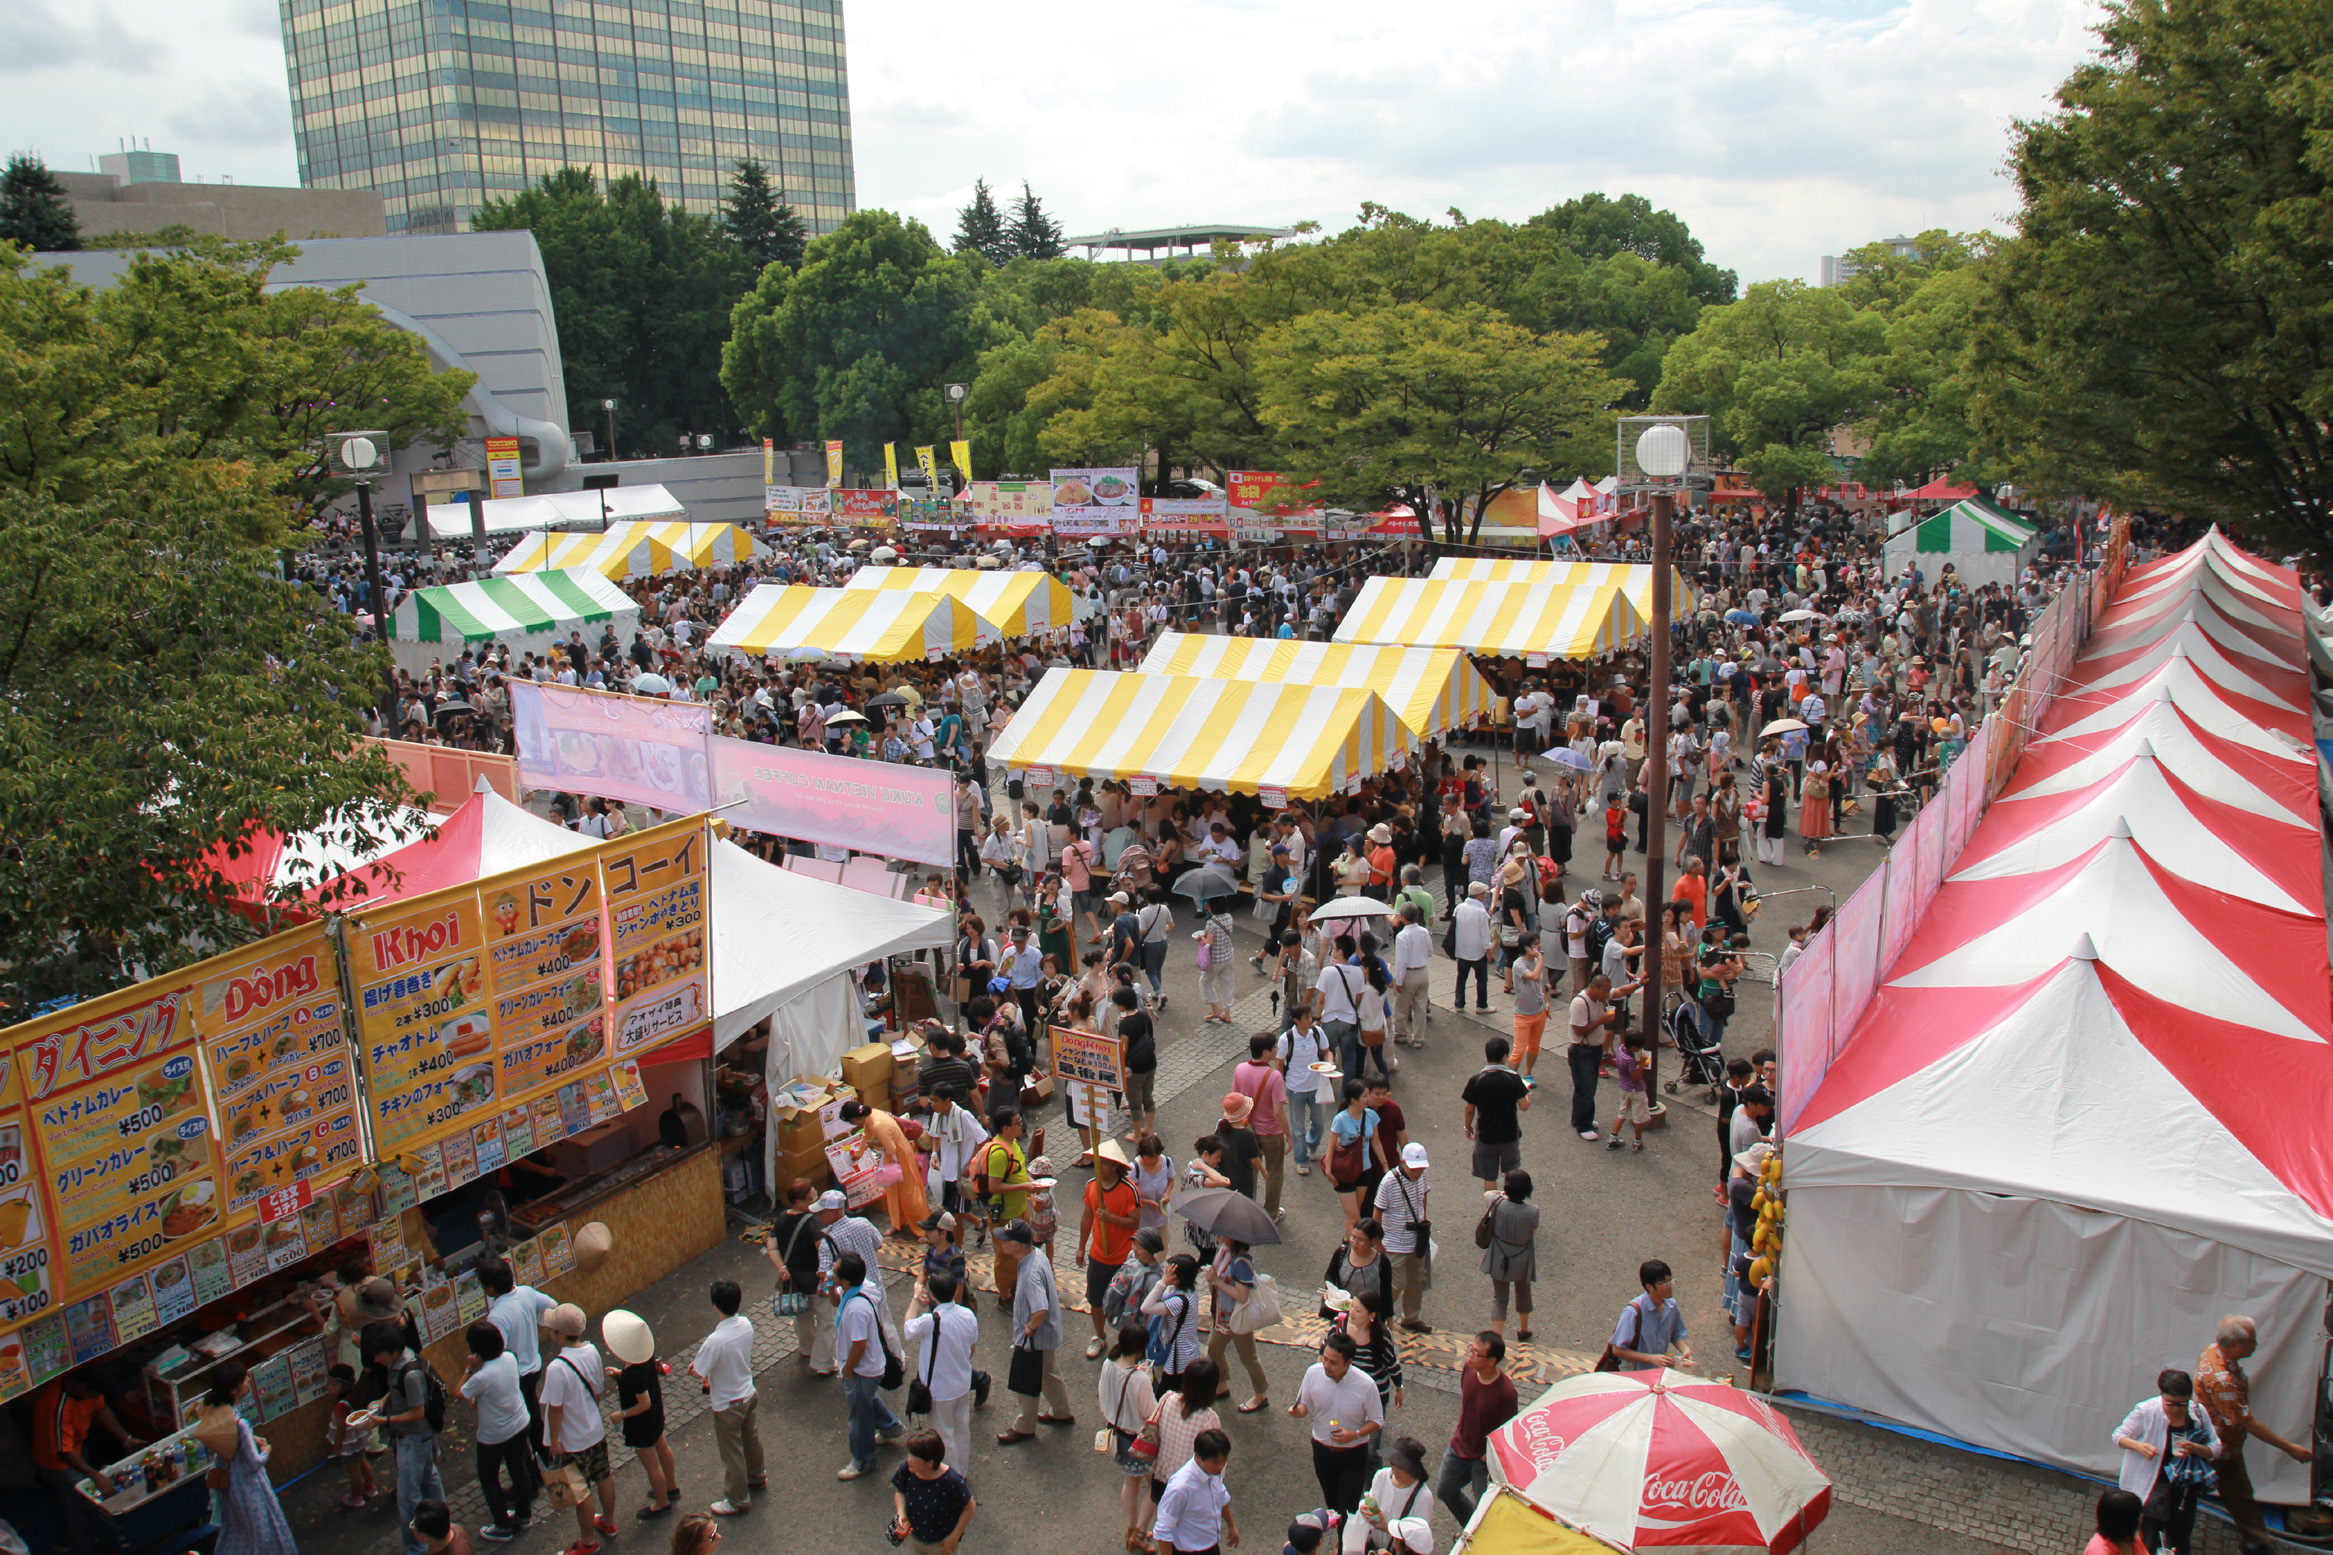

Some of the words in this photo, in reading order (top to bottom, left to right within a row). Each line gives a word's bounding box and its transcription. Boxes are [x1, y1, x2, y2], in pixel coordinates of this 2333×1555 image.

[1237, 485, 1260, 499] 池袋
[528, 875, 593, 929] ドン
[608, 833, 696, 895] コーイ
[649, 881, 700, 908] ベトナム風
[616, 895, 699, 938] ジャンボやきとり
[666, 910, 701, 931] ¥300
[493, 932, 569, 962] ベトナムカレーフォー
[537, 954, 570, 977] ¥400
[363, 970, 433, 1009] 揚げ春巻き
[499, 984, 572, 1018] グリーンカレーフォー
[395, 1014, 413, 1028] 2本
[413, 996, 450, 1021] ¥300
[541, 1006, 574, 1029] ¥400
[216, 1015, 291, 1063] ハーフ&ハーフ
[308, 1027, 341, 1053] ¥700
[626, 1010, 683, 1044] 大盛りサービス
[31, 993, 182, 1098] ダイニング
[372, 1025, 440, 1065] チャオトム
[268, 1051, 307, 1070] グリーンカレー
[418, 1049, 454, 1075] ¥400
[545, 1054, 576, 1078] ¥400
[220, 1071, 261, 1095] ベトナムカレー
[43, 1085, 135, 1126] ベトナムカレー
[226, 1073, 301, 1121] ハーフ&ハーフ
[317, 1084, 348, 1110] ¥700
[379, 1079, 455, 1118] チキンのフォー
[118, 1104, 163, 1138] ¥500
[427, 1101, 461, 1126] ¥300
[47, 1122, 87, 1142] Vietnam
[88, 1112, 115, 1126] Curry
[226, 1127, 266, 1152] ベトナムカレー
[230, 1129, 311, 1177] ハーフ&ハーフ
[326, 1138, 357, 1164] ¥700
[56, 1145, 147, 1194] グリーンカレー
[128, 1163, 174, 1197] ¥500
[60, 1187, 90, 1206] Green
[91, 1176, 118, 1192] Curry
[230, 1184, 278, 1210] グリーンカレー
[269, 1185, 299, 1206] ご注文
[274, 1198, 299, 1217] コチラ
[103, 1238, 124, 1251] Rice
[118, 1233, 163, 1264] ¥500
[274, 1247, 304, 1267] ¥500
[5, 1248, 48, 1277] ¥200
[250, 1266, 268, 1280] ¥400
[212, 1283, 233, 1297] ¥400
[6, 1290, 49, 1320] ¥100
[176, 1301, 196, 1316] ¥400
[472, 1307, 487, 1320] ¥300
[136, 1320, 158, 1335] ¥300
[443, 1320, 459, 1333] ¥400
[279, 1401, 297, 1414] ¥700
[1642, 1470, 1748, 1510] Coca-Cola
